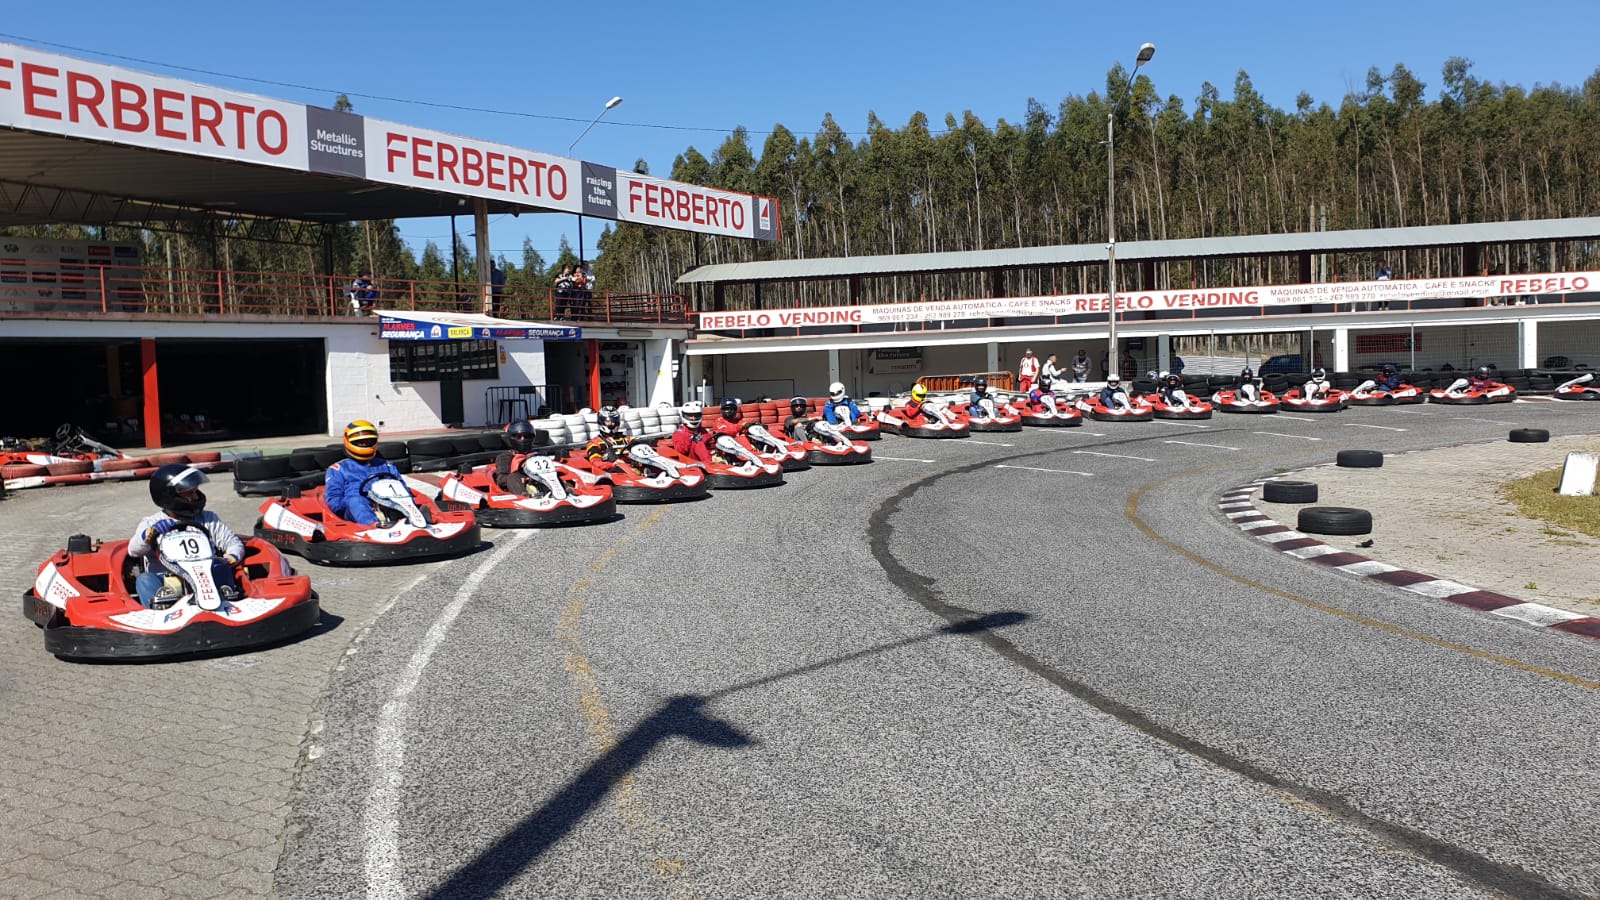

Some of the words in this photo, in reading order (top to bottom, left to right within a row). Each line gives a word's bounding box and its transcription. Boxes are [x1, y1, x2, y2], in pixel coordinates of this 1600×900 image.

[316, 129, 357, 146] Metallic
[310, 139, 364, 158] Structures
[387, 132, 567, 200] FERBERTO
[586, 177, 612, 190] raising
[593, 186, 606, 196] the
[588, 194, 612, 207] future
[629, 180, 744, 230] FERBERTO
[1317, 286, 1329, 294] DE
[1331, 285, 1359, 293] VENDA
[1459, 279, 1495, 287] SNACKS
[1500, 277, 1589, 293] REBELO
[925, 304, 951, 312] VENDA
[1039, 298, 1071, 307] SNACKS
[1075, 295, 1153, 311] REBELO
[1164, 291, 1259, 307] VENDING
[702, 314, 771, 329] REBELO
[779, 310, 862, 325] VENDING
[381, 330, 425, 340] SEGURANÇA
[528, 329, 564, 337] SEGURANÇA
[534, 459, 551, 470] 32
[179, 538, 200, 555] 19
